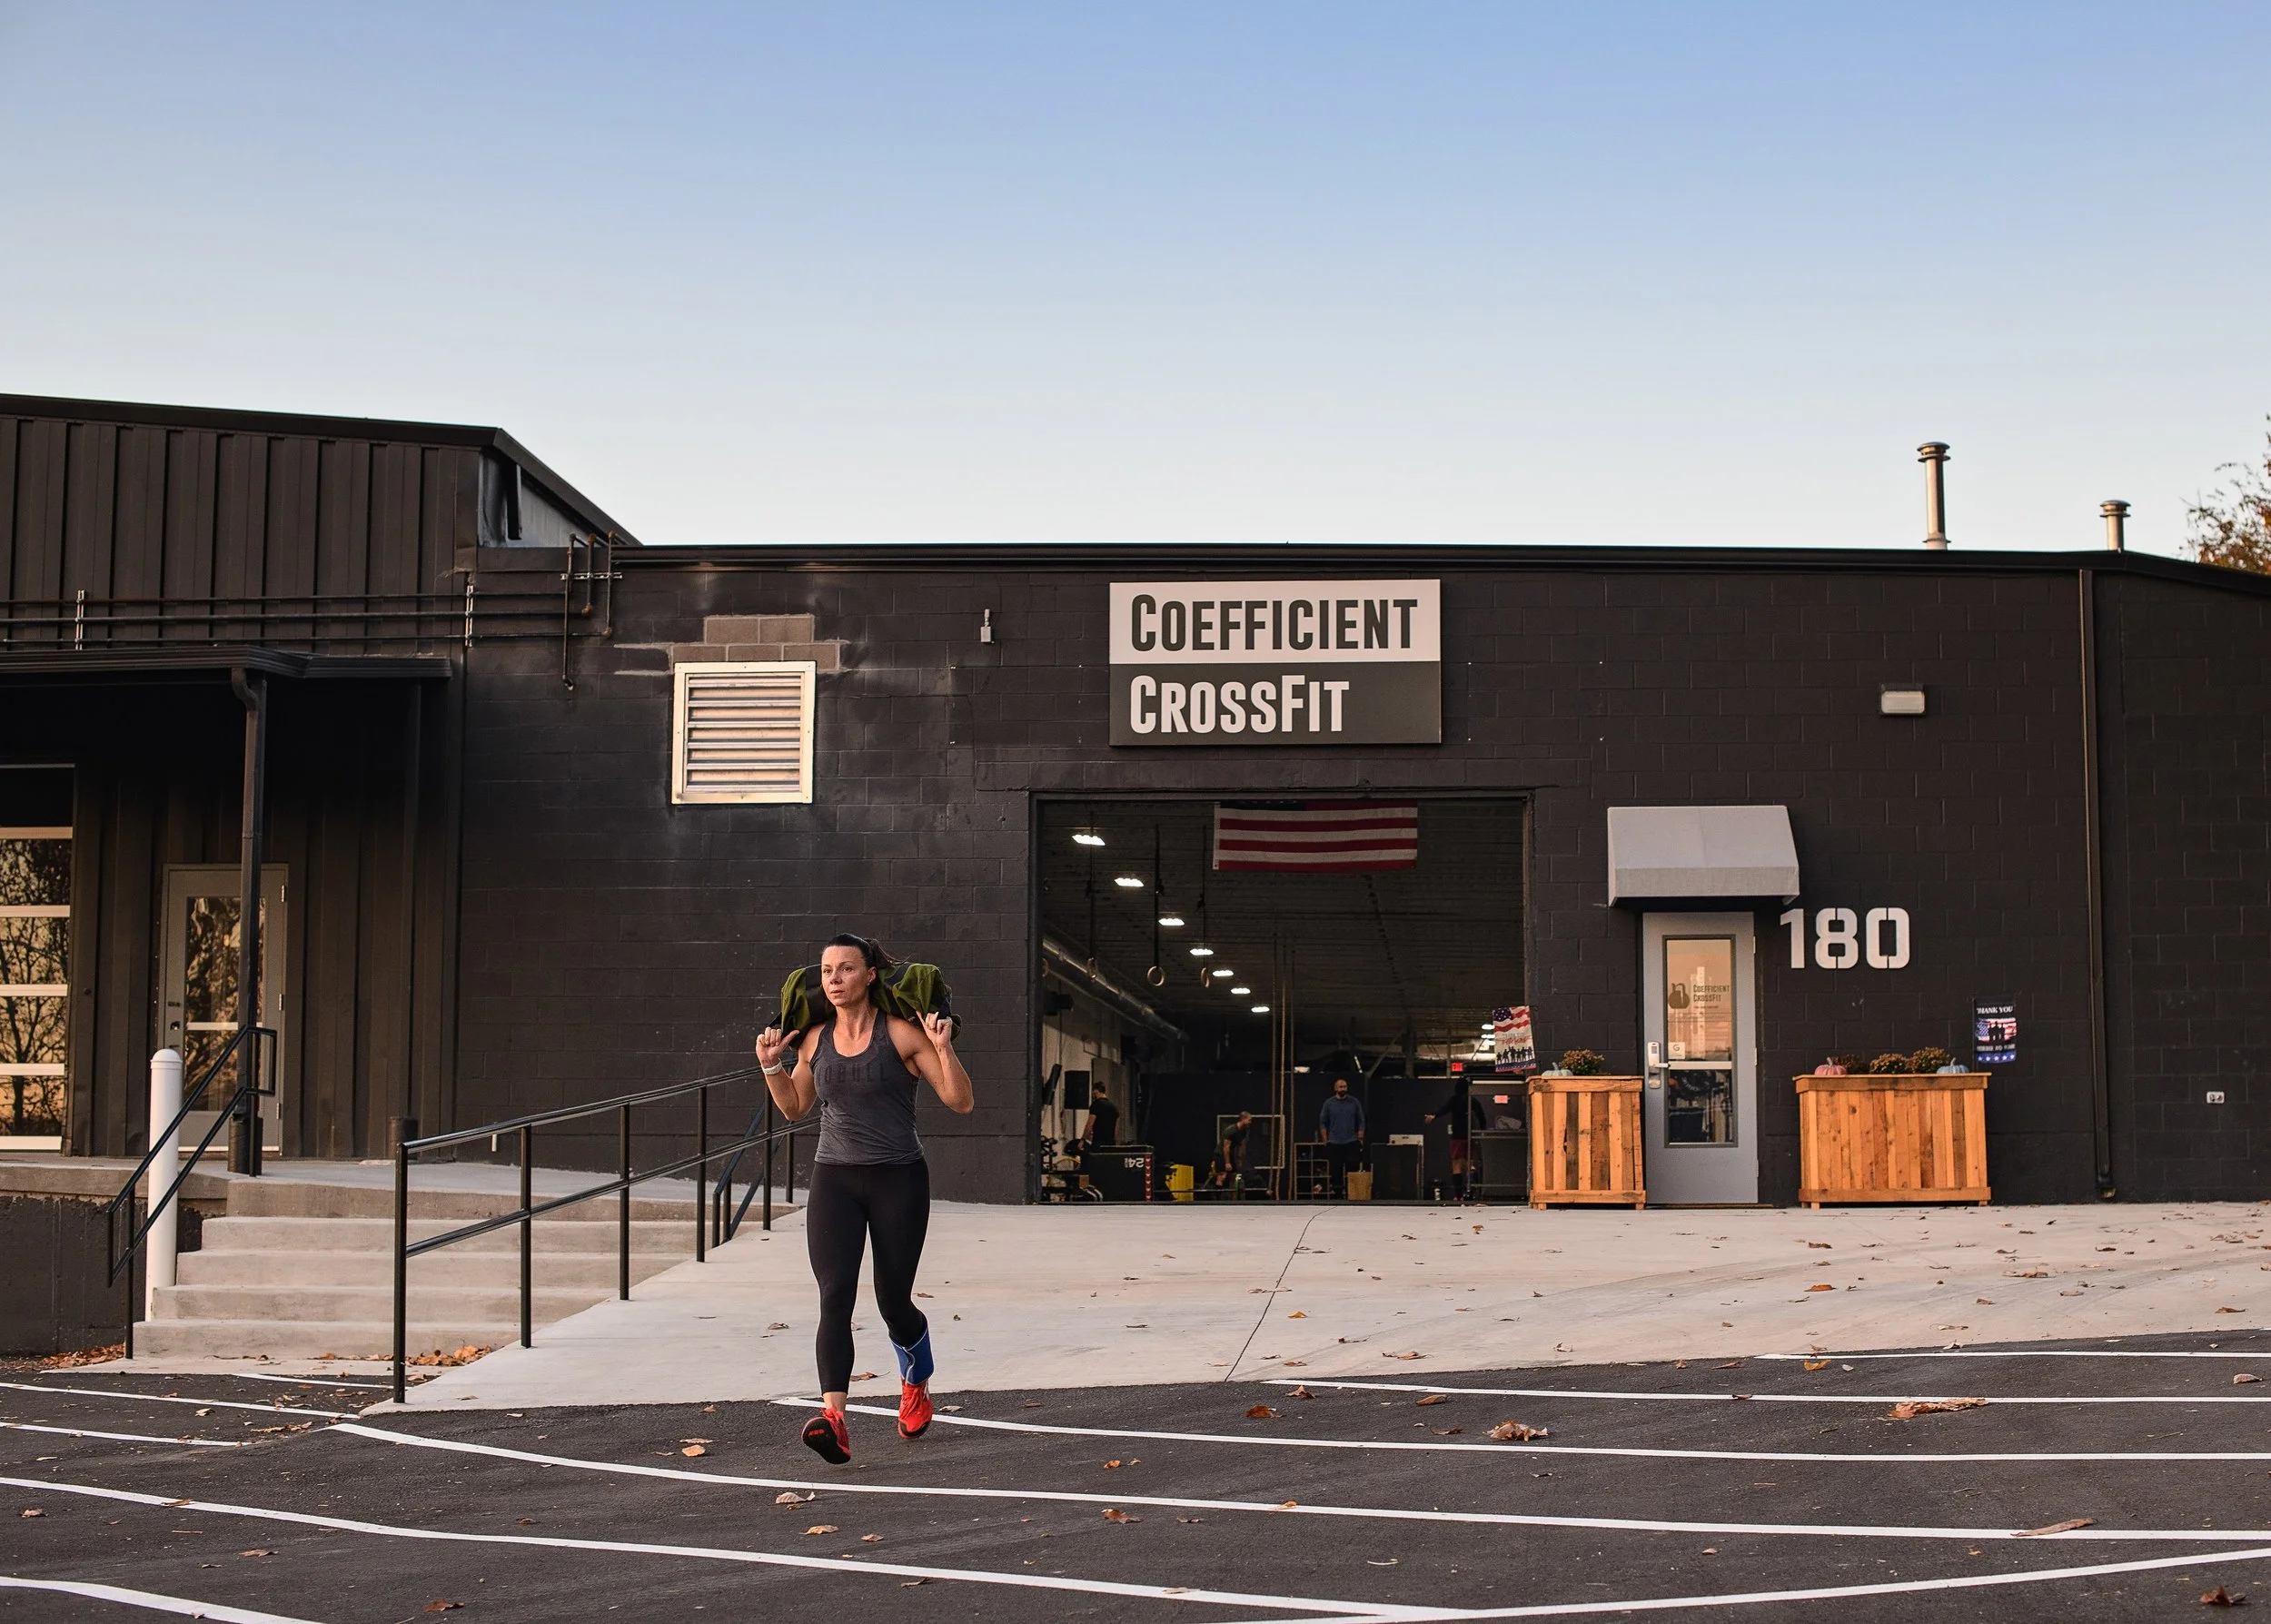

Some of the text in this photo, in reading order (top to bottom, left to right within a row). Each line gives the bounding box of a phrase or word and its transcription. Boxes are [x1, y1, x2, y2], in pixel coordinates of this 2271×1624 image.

[1131, 593, 1418, 651] COEFFICIENT
[1130, 674, 1350, 734] CROSSFIT
[1780, 906, 1910, 970] 180
[1692, 985, 1730, 993] COEFFICIENT
[1692, 994, 1721, 1002] CROSSFIT
[1976, 1005, 2014, 1015] THANK YOU
